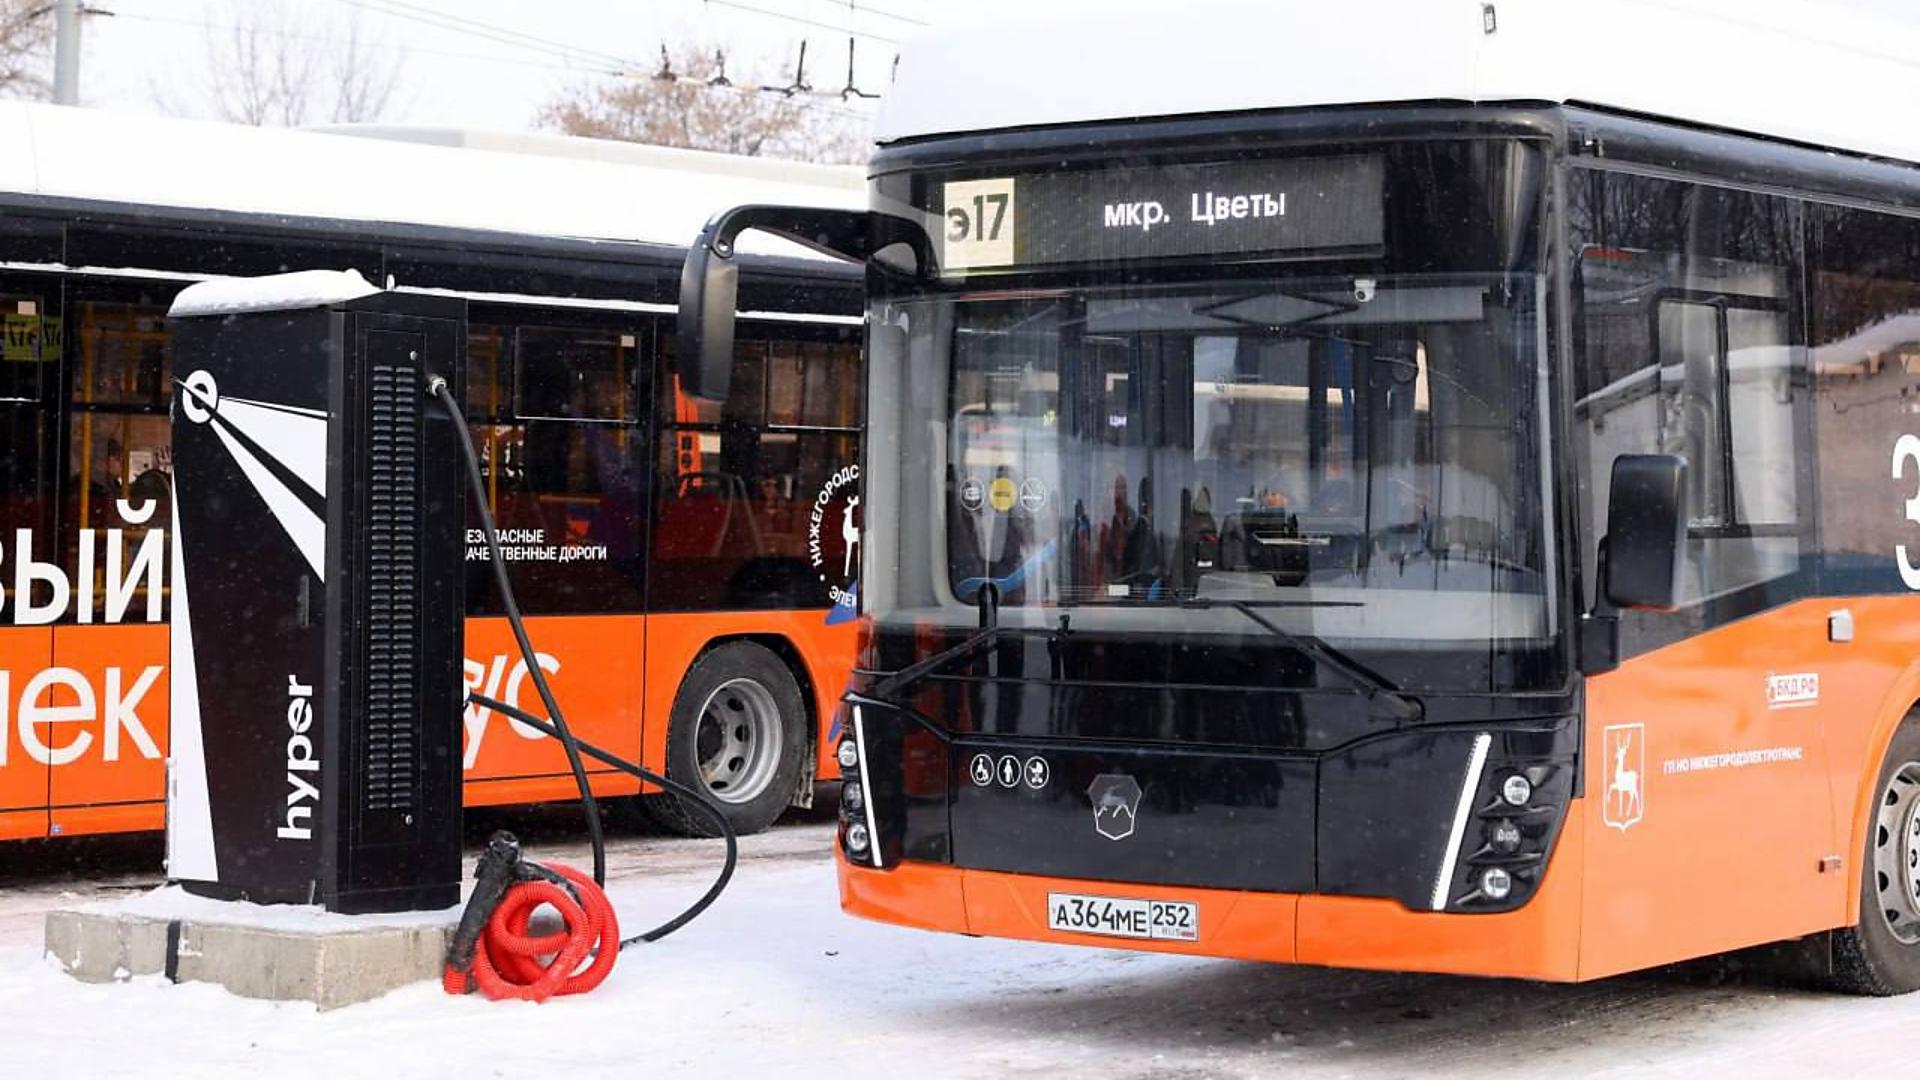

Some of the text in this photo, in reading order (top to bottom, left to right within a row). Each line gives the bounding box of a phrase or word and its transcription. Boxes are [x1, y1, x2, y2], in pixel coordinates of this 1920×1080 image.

[946, 192, 1009, 243] э17
[1104, 191, 1286, 231] мкр. Цветы
[558, 545, 607, 563] ДОРОГИ
[277, 674, 320, 840] hyper
[1152, 904, 1190, 928] 252
